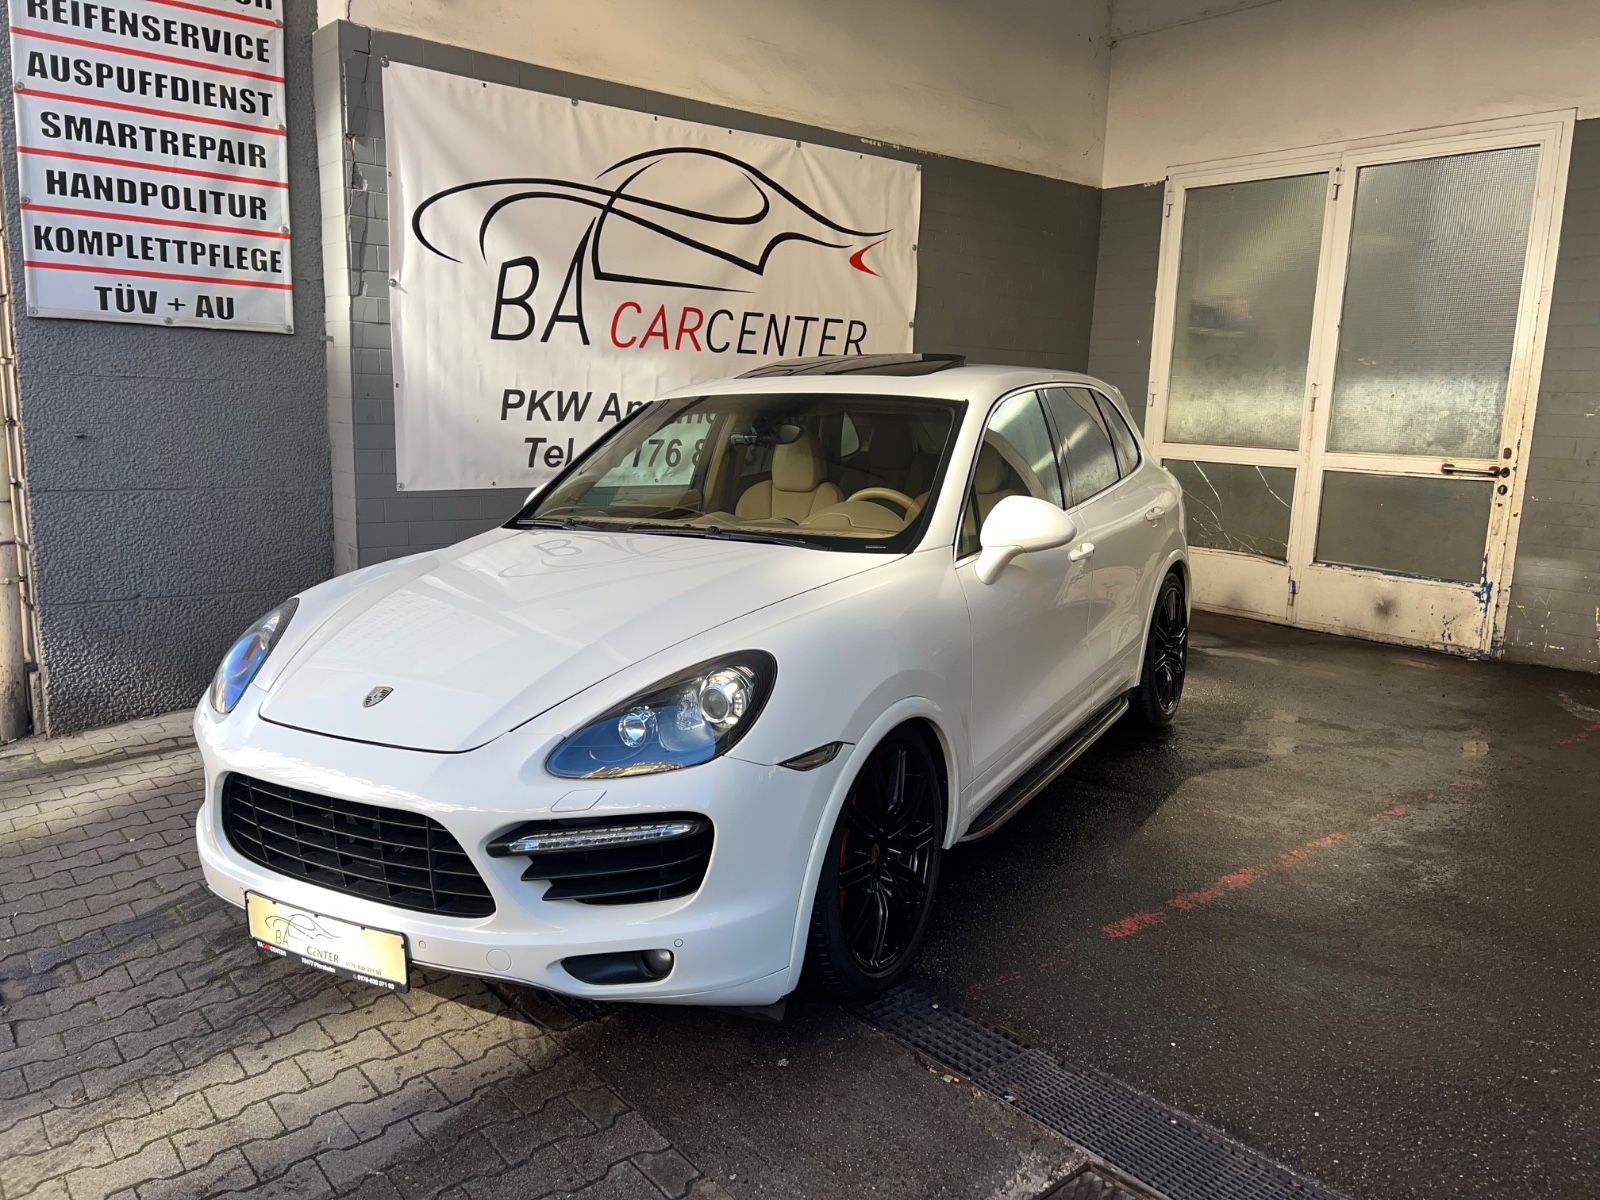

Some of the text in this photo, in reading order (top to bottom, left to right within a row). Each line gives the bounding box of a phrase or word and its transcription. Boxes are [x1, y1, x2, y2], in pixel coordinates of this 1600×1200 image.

[27, 0, 270, 63] REIFENSERVICE
[27, 51, 273, 117] AUSPUFFDIENST
[40, 111, 267, 168] SMARTREPAIR
[46, 169, 267, 221] HANDPOLITUR
[34, 225, 282, 273] KOMPLETTPFLEGE
[94, 283, 158, 314] TÜV
[195, 294, 234, 320] AU
[491, 217, 867, 357] BA CARCENTER
[500, 389, 592, 422] PKW
[630, 439, 682, 468] 176
